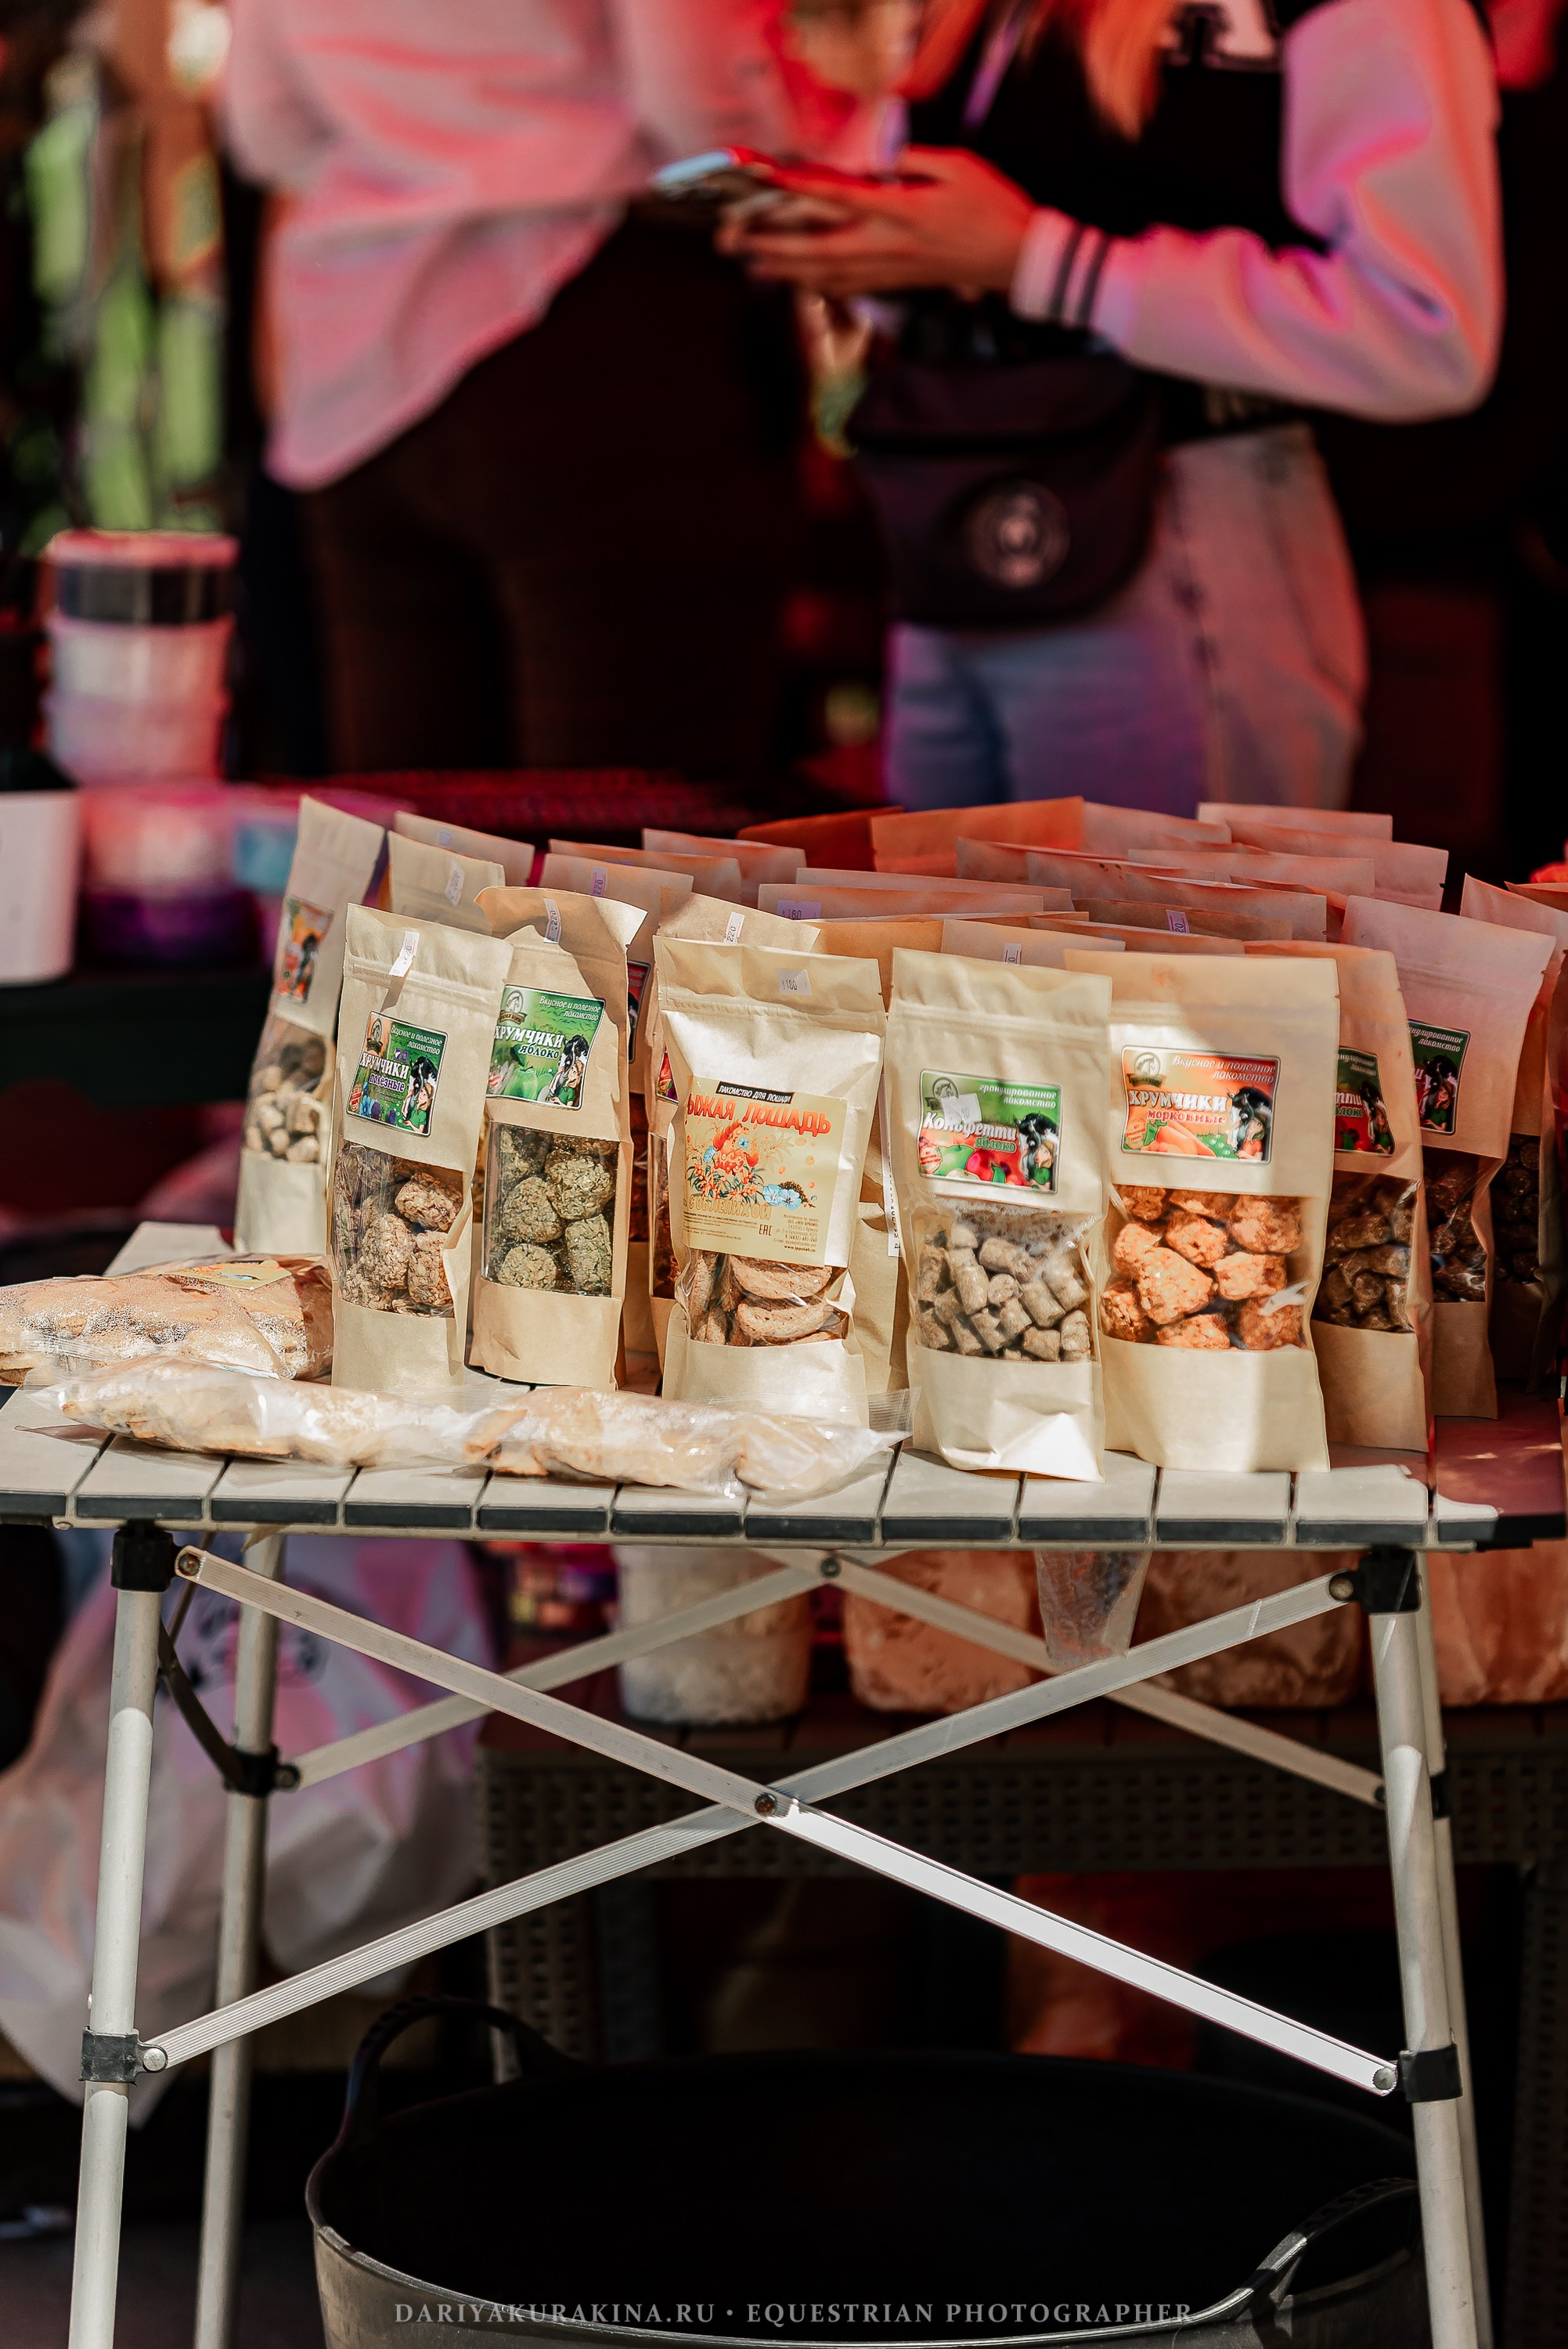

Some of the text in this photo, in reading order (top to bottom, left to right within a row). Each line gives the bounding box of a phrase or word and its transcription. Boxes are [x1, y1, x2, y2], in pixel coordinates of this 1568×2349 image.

[539, 996, 567, 1008] Вкусное
[573, 1002, 601, 1013] полезное
[564, 1011, 600, 1021] лакомство
[391, 1025, 411, 1039] Вкусное
[415, 1034, 443, 1046] полезное
[495, 1026, 564, 1048] ХРУМЧИКИ
[407, 1041, 441, 1055] лакомство
[519, 1042, 560, 1059] яблоко
[1418, 1038, 1461, 1052] лакомство
[360, 1052, 409, 1080] ХРУМЧИКИ
[1173, 1056, 1276, 1073] Вкусное и полезное
[1212, 1071, 1274, 1083] лакомство
[719, 1085, 791, 1103] ЛАКОМСТВО ДЛЯ ЛОШАДИ
[980, 1084, 1057, 1099] гранулированное
[1004, 1098, 1056, 1109] лакомство
[1129, 1090, 1227, 1112] ХРУМЧИКИ
[687, 1093, 831, 1137] ЫЖАЯ ЛОШАДЬ
[975, 1136, 1016, 1153] яблоко
